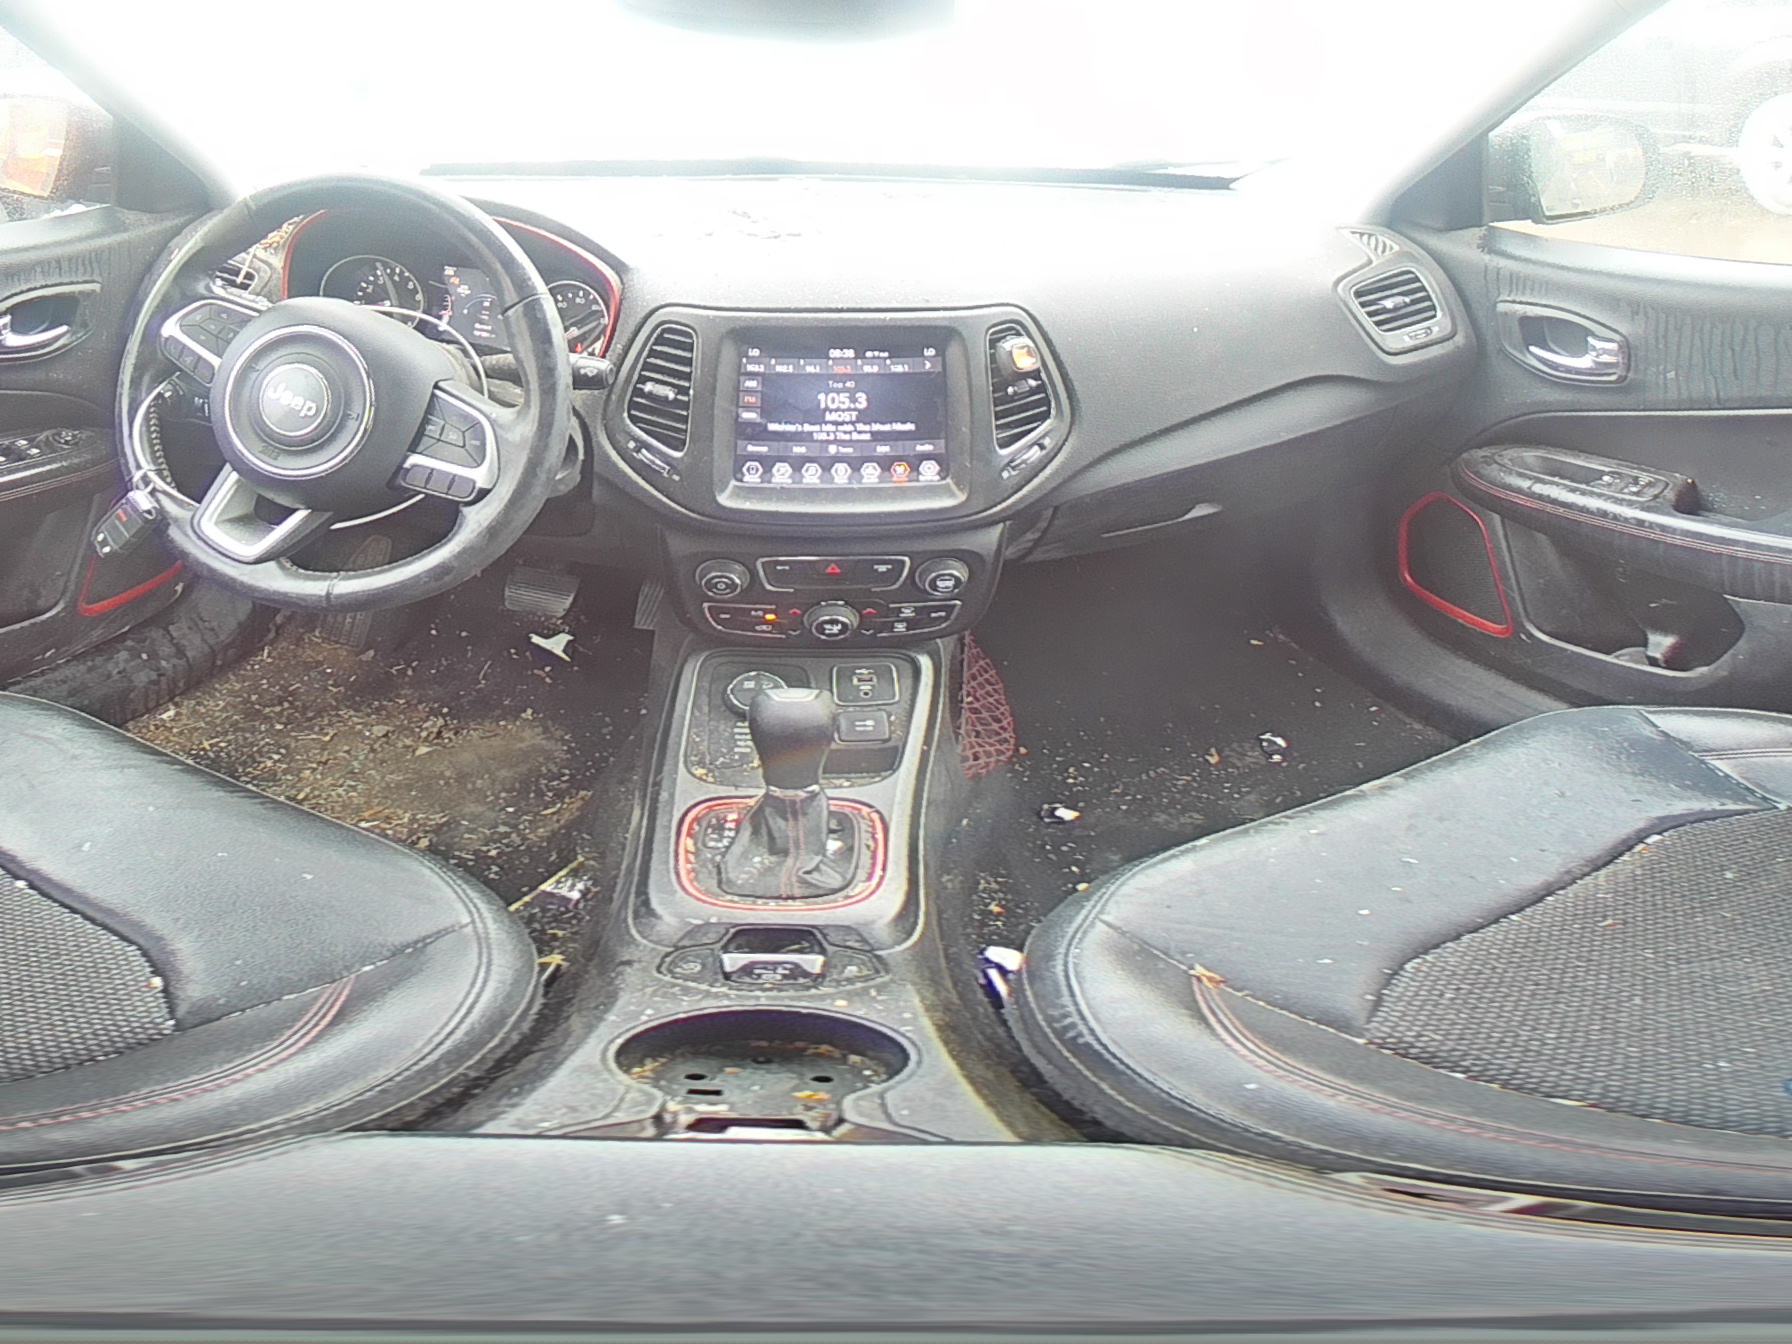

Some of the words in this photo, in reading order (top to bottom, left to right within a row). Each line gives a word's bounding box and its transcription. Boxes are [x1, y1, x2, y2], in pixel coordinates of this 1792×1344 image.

[267, 382, 317, 418] Jeep
[817, 391, 868, 410] 105.3
[825, 411, 859, 421] MOST
